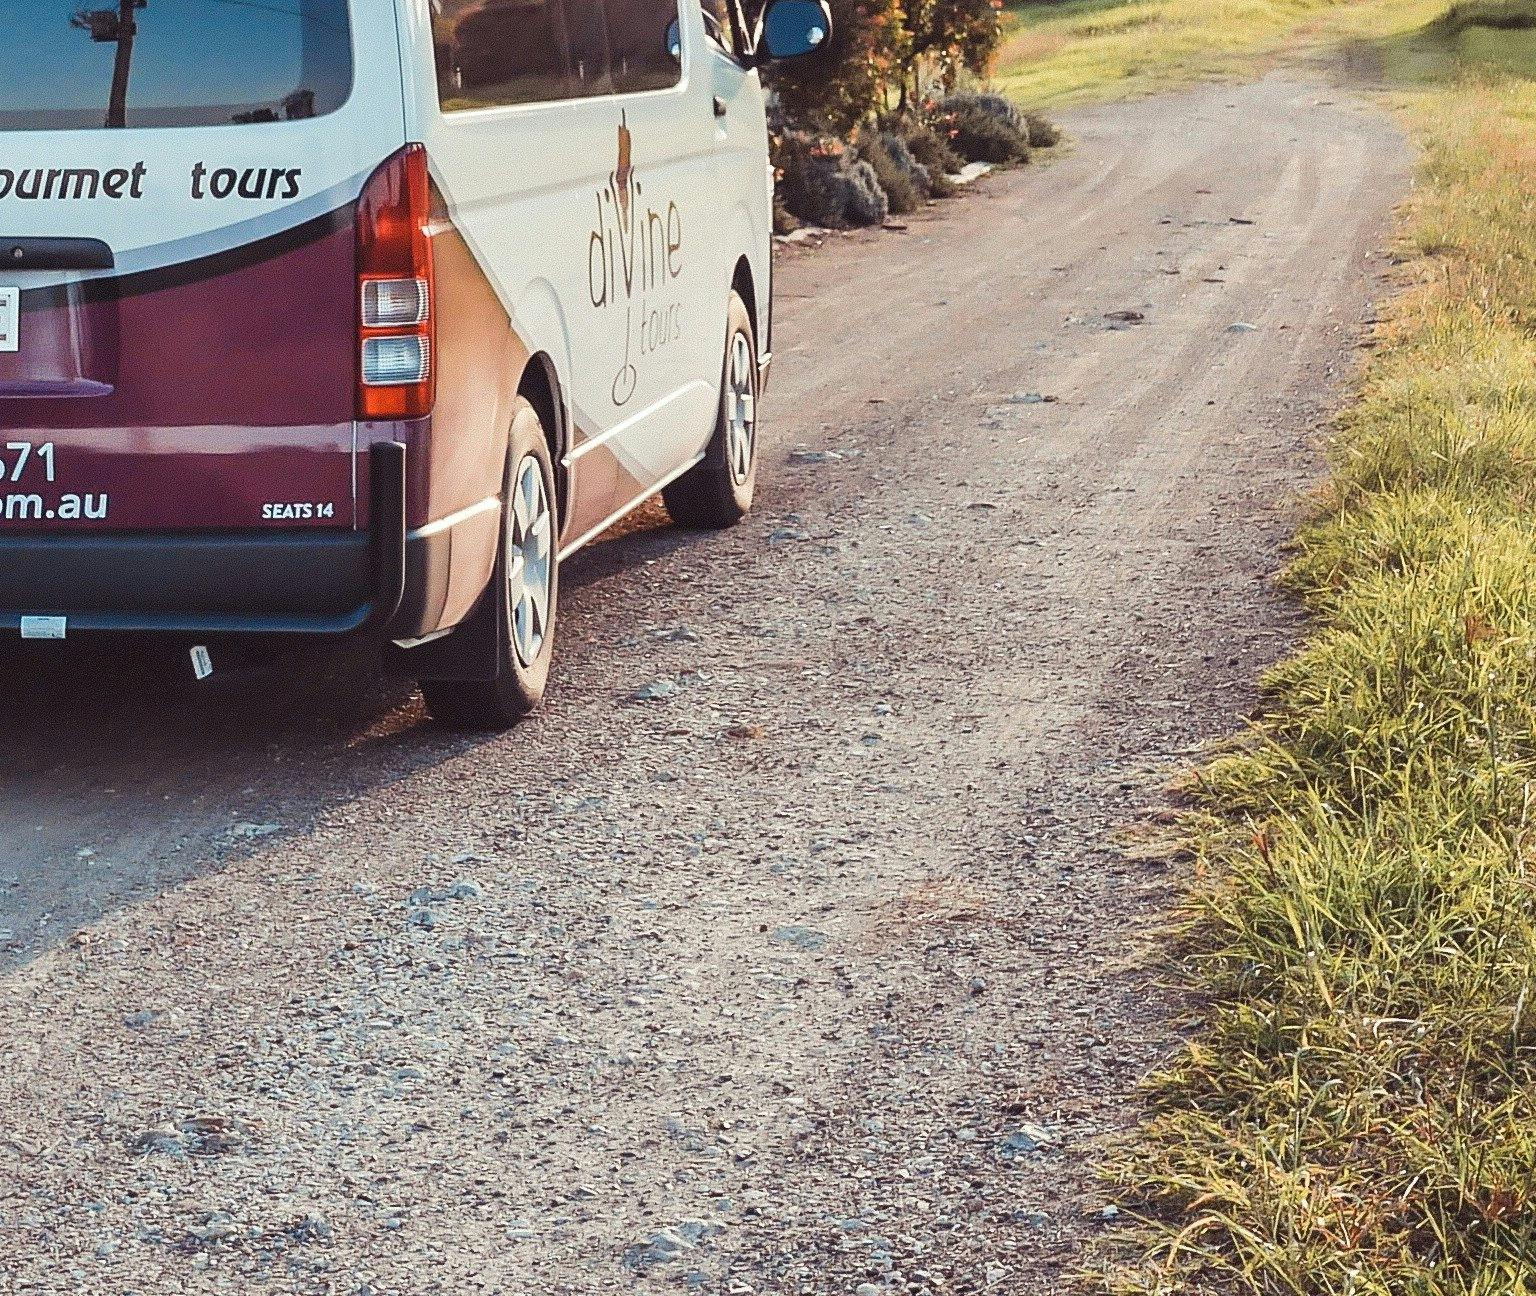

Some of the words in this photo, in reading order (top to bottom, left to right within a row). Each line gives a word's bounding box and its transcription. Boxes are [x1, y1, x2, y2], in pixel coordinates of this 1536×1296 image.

[190, 160, 302, 200] tours
[639, 298, 682, 355] tours
[261, 503, 313, 519] SEATS
[316, 502, 334, 518] 14
